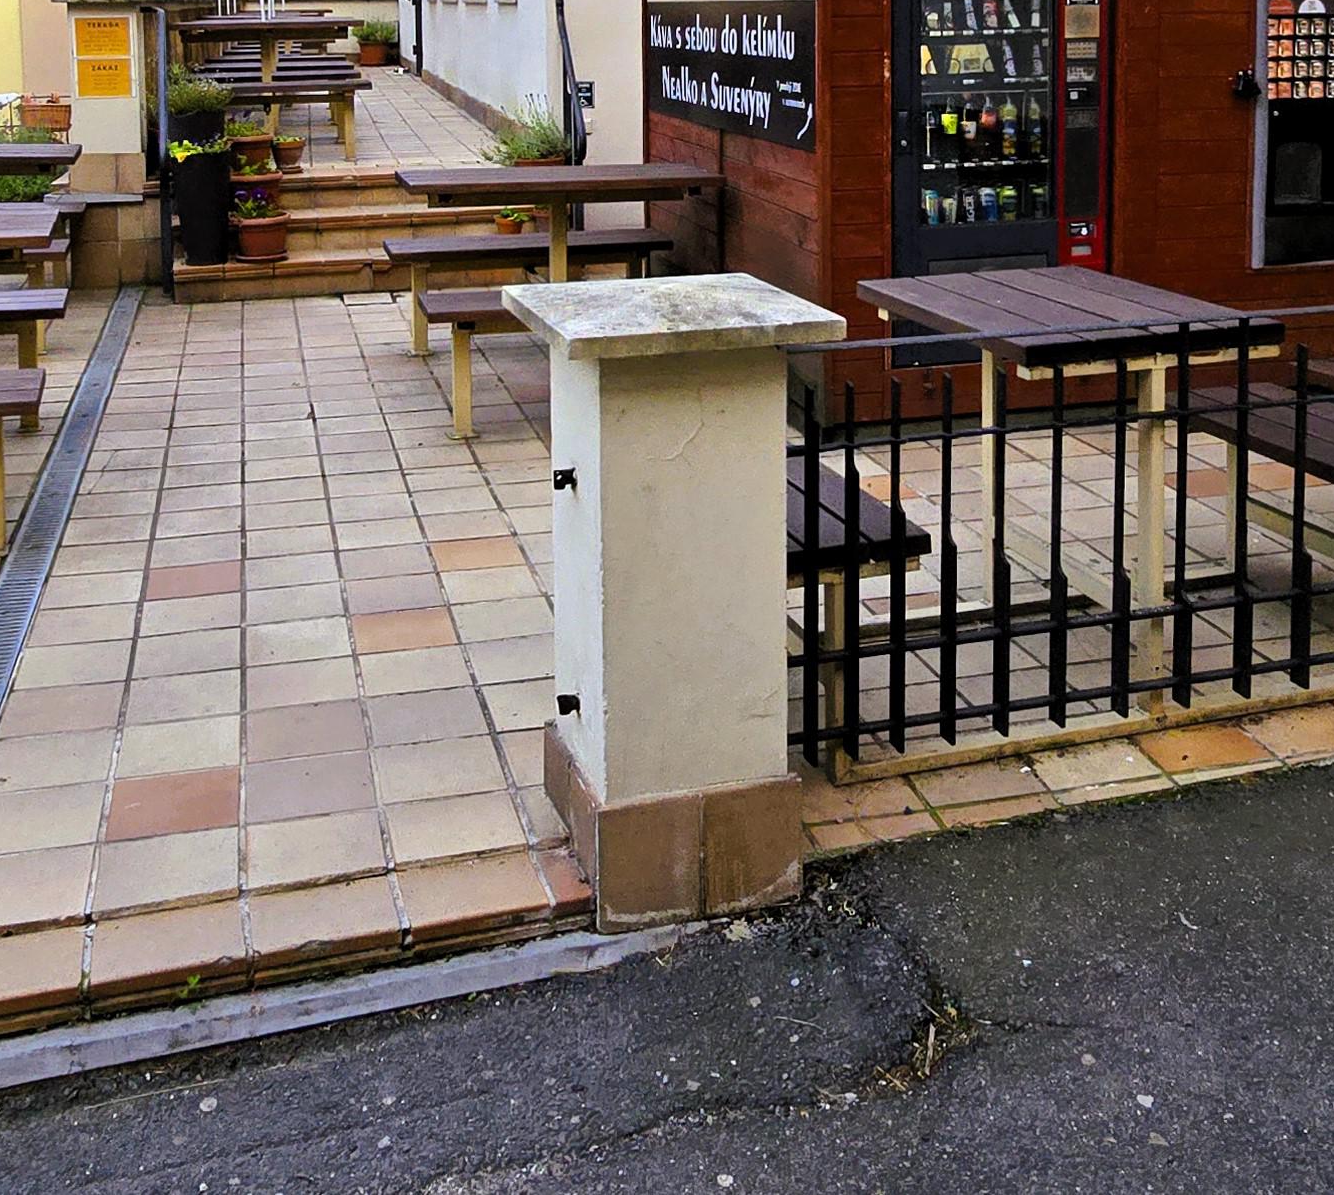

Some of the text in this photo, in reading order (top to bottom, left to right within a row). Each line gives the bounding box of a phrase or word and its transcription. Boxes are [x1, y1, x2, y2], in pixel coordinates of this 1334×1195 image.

[650, 13, 795, 61] Káva s sebou do kelímku
[661, 65, 698, 105] Nealko
[710, 72, 772, 129] Suvenýry
